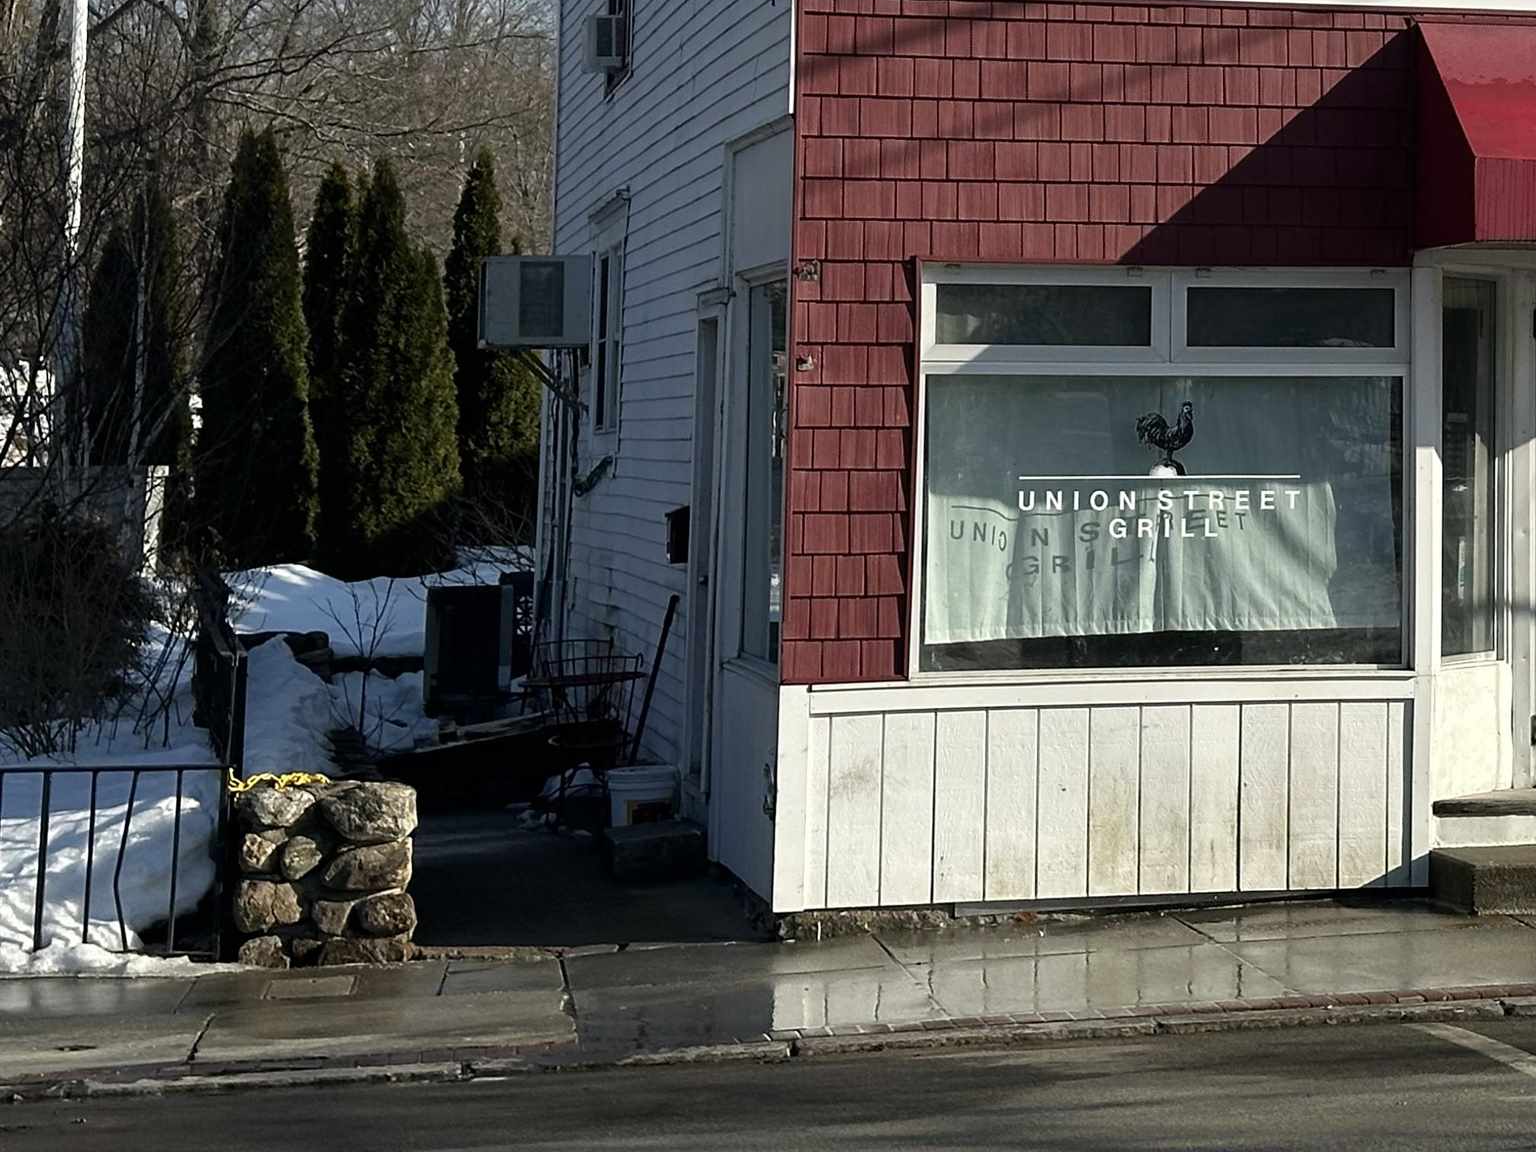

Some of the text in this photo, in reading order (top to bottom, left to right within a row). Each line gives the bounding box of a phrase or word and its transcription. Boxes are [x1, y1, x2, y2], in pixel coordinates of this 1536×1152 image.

[1018, 490, 1300, 511] UNION STREET
[1109, 518, 1219, 538] GRILL
